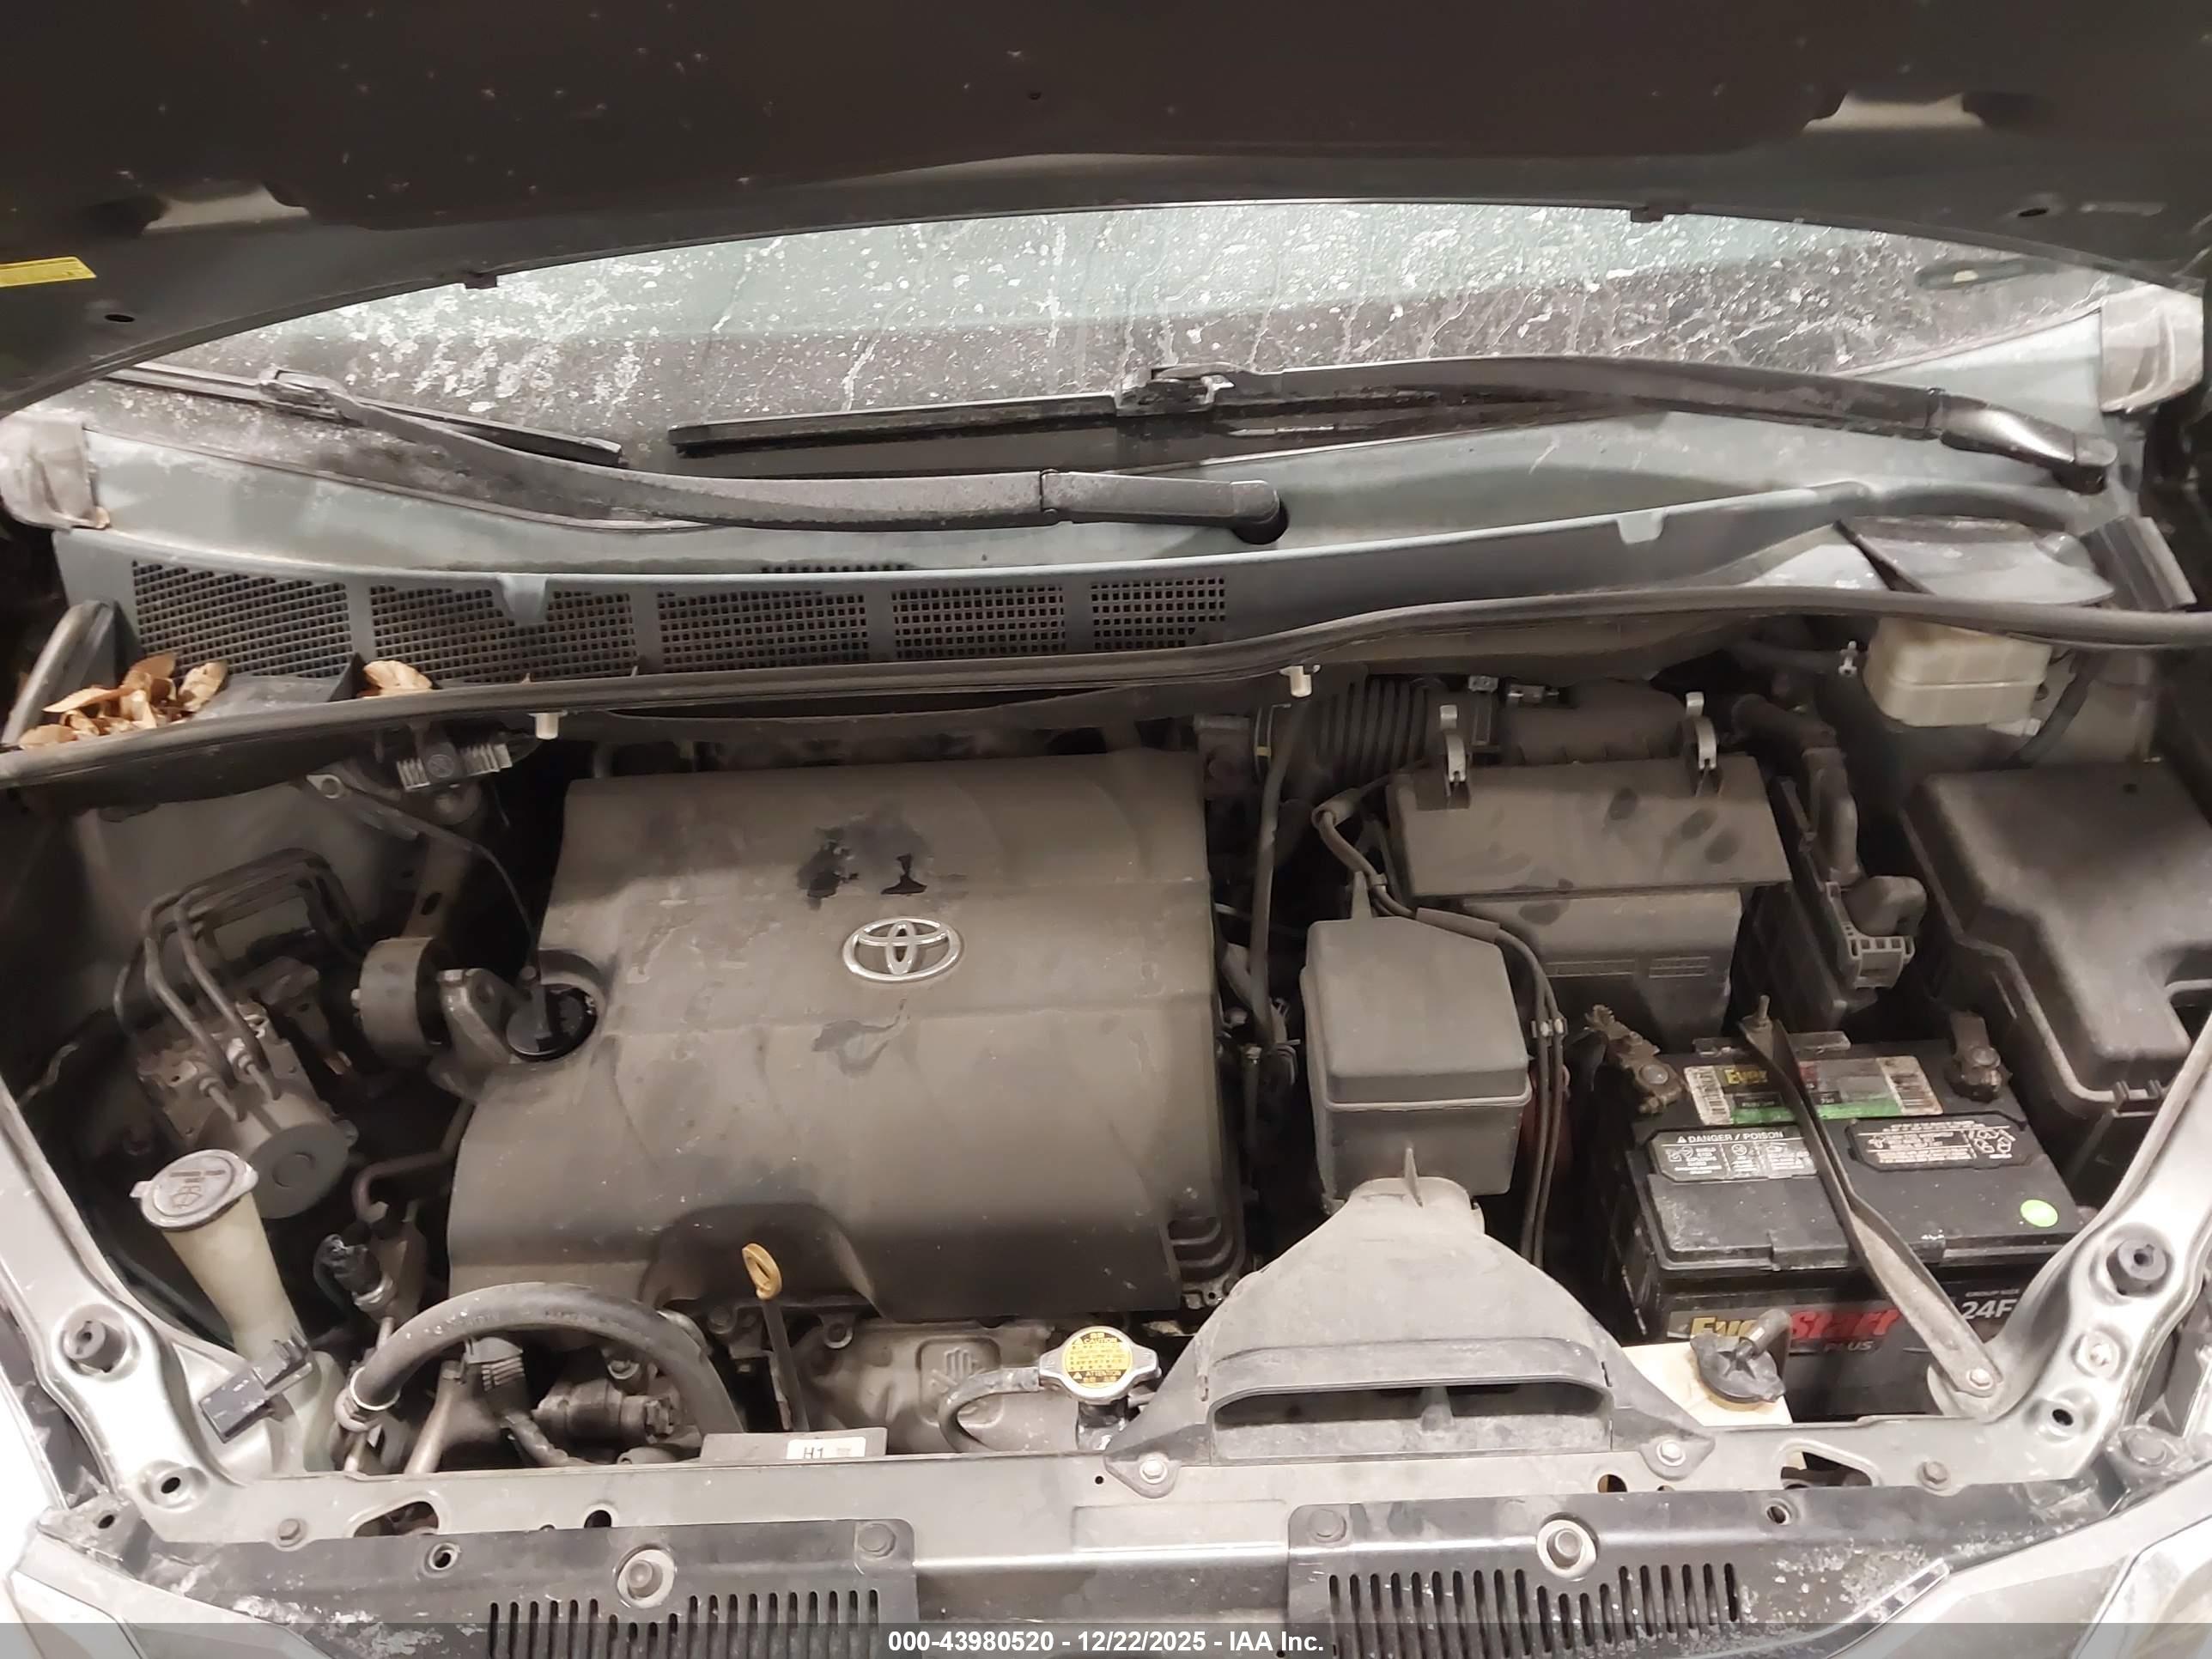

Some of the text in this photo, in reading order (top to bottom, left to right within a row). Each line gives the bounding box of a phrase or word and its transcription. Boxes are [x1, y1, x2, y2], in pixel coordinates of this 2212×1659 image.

[1687, 1133, 1733, 1144] DANGER
[1742, 1131, 1784, 1140] POISON
[1961, 1298, 2017, 1320] 24F
